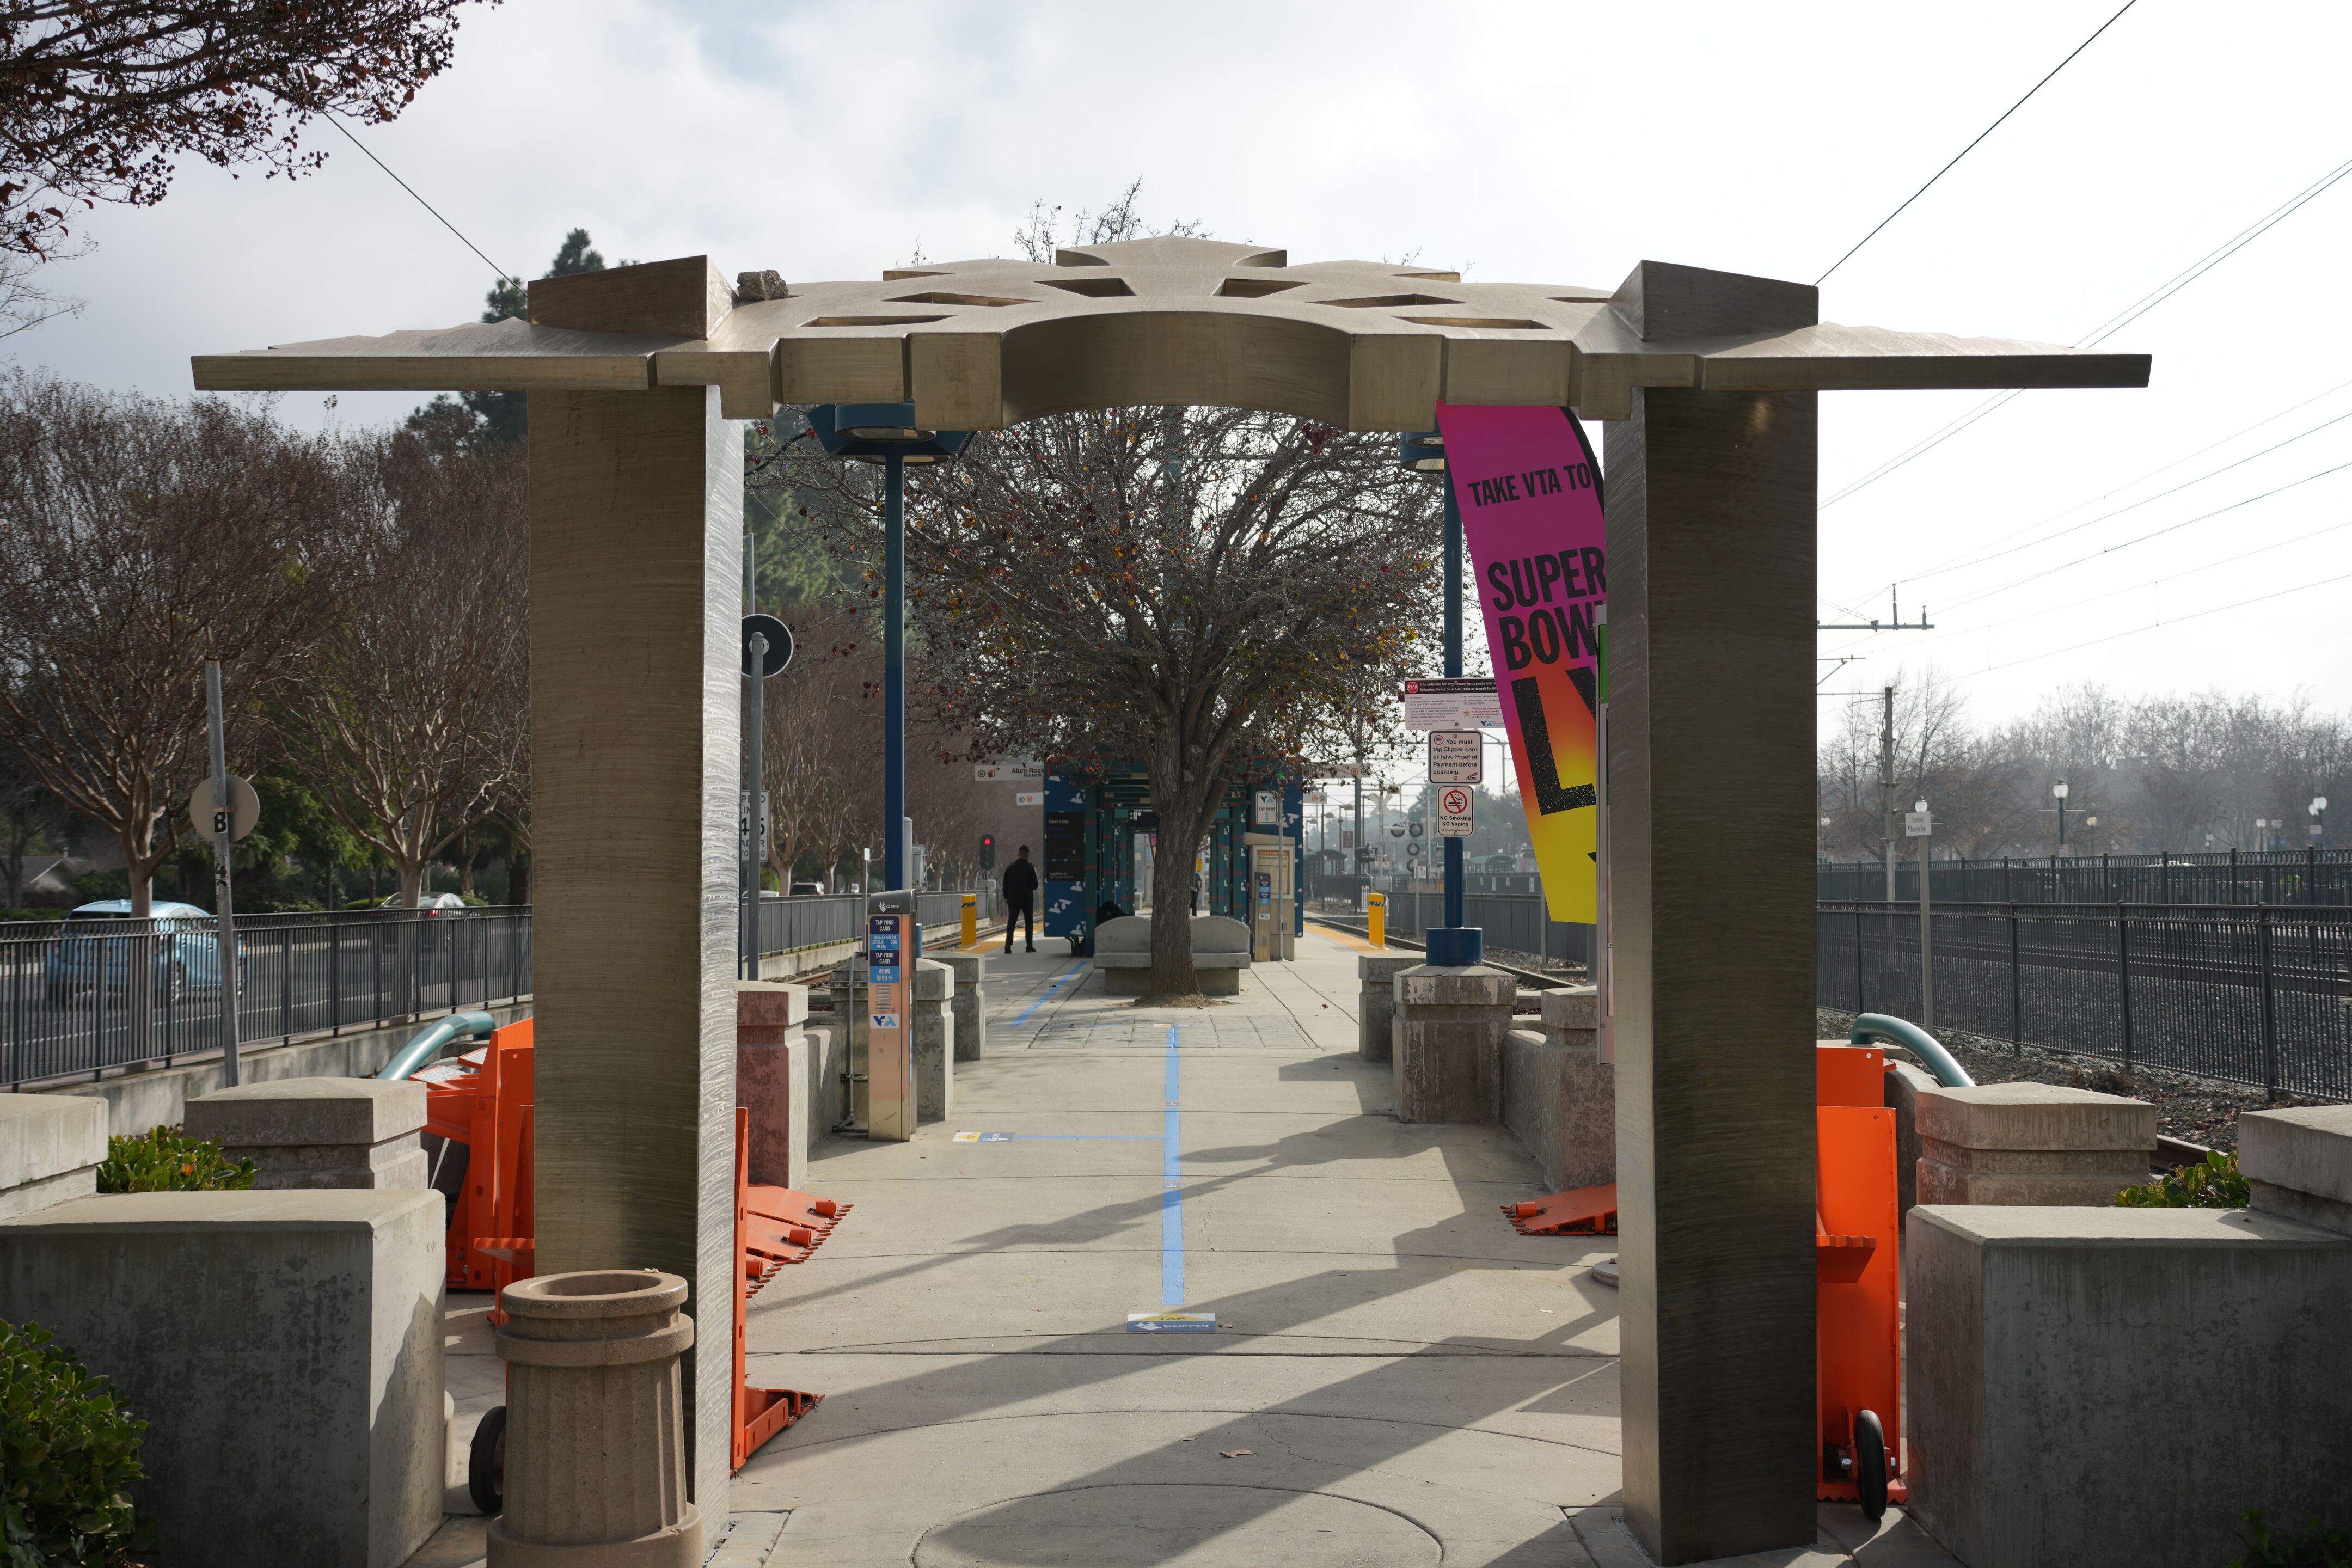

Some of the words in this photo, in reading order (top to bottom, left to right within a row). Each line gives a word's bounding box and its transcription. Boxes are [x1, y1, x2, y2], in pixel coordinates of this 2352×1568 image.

[1468, 475, 1520, 507] TAKE
[1522, 468, 1562, 498] VTA
[1564, 463, 1591, 490] TO
[1487, 546, 1606, 611] SUPER
[1499, 600, 1604, 671] BOW
[214, 812, 226, 832] B
